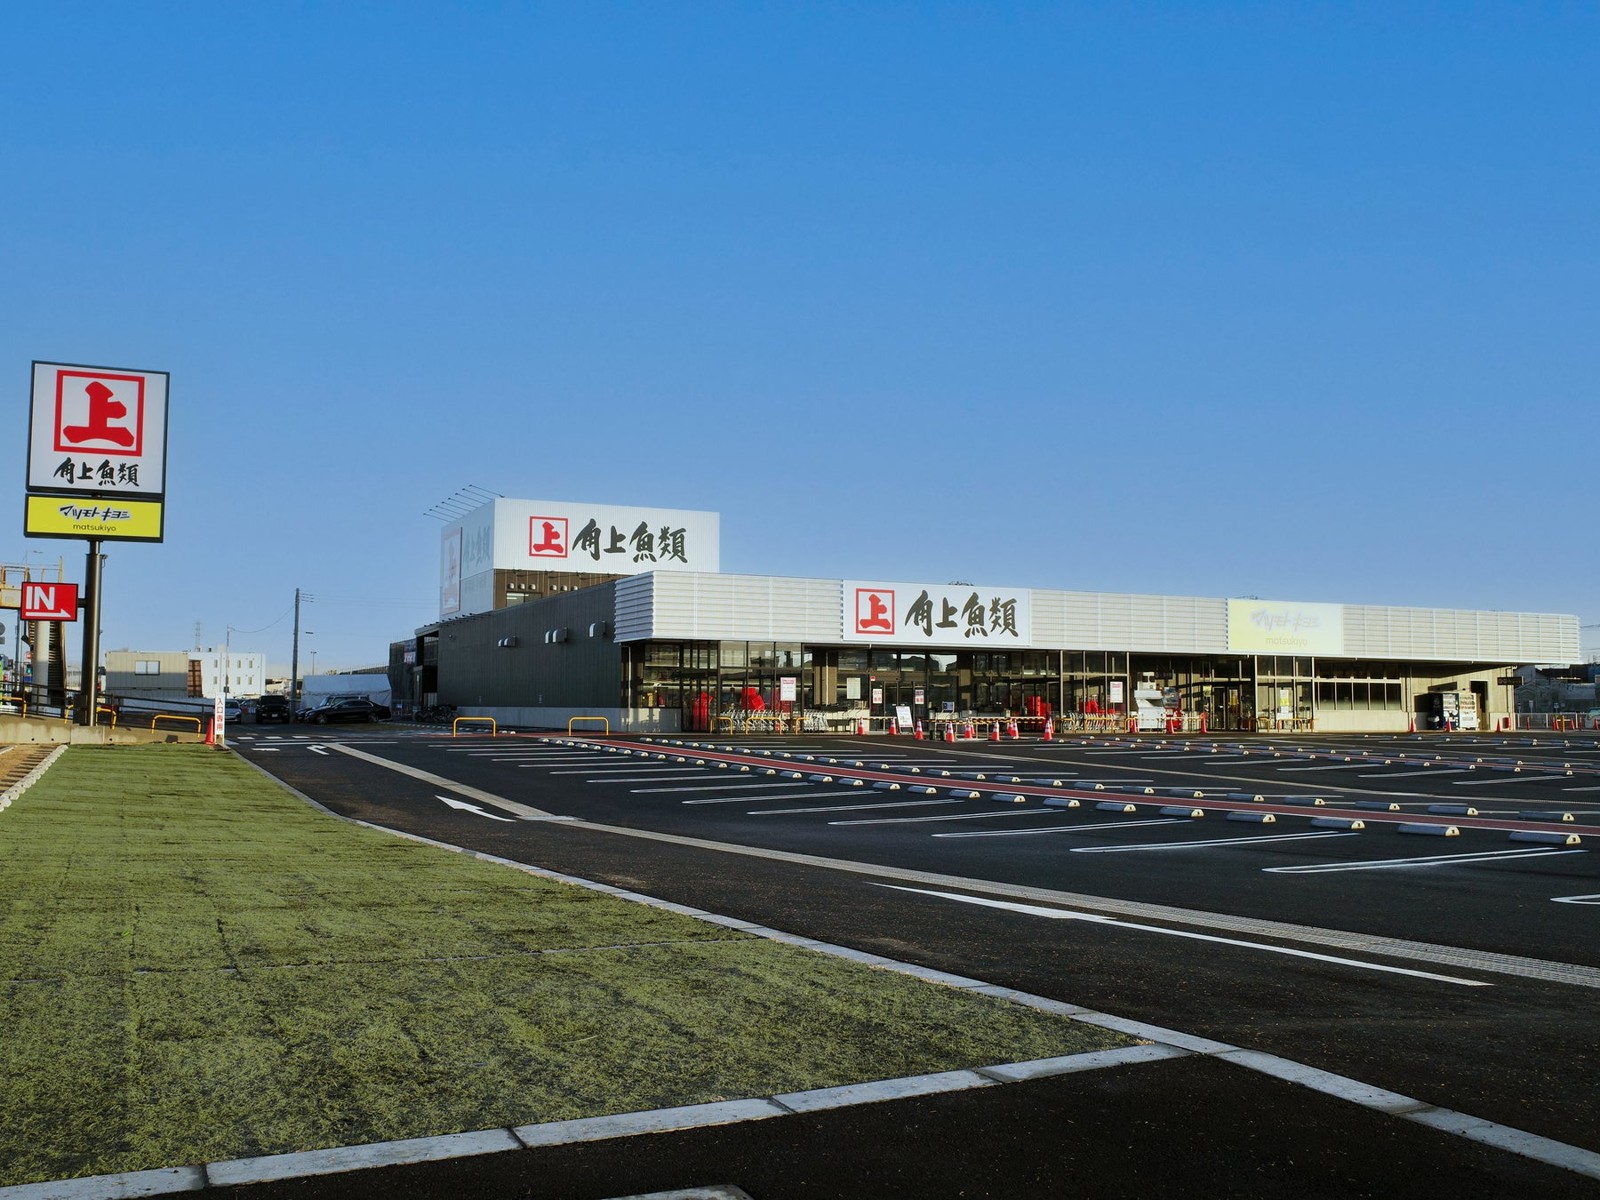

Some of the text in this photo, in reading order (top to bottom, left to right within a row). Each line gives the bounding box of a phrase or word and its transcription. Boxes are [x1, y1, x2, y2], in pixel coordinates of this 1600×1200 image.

[62, 380, 135, 449] 上
[53, 456, 140, 488] 角上魚類
[59, 504, 132, 523] マツモトキヨシ
[72, 522, 117, 533] matsukiyo
[571, 518, 689, 564] 角上魚類
[25, 585, 55, 610] IN
[905, 589, 1020, 638] 角上魚類
[1265, 635, 1309, 648] matsukiyo
